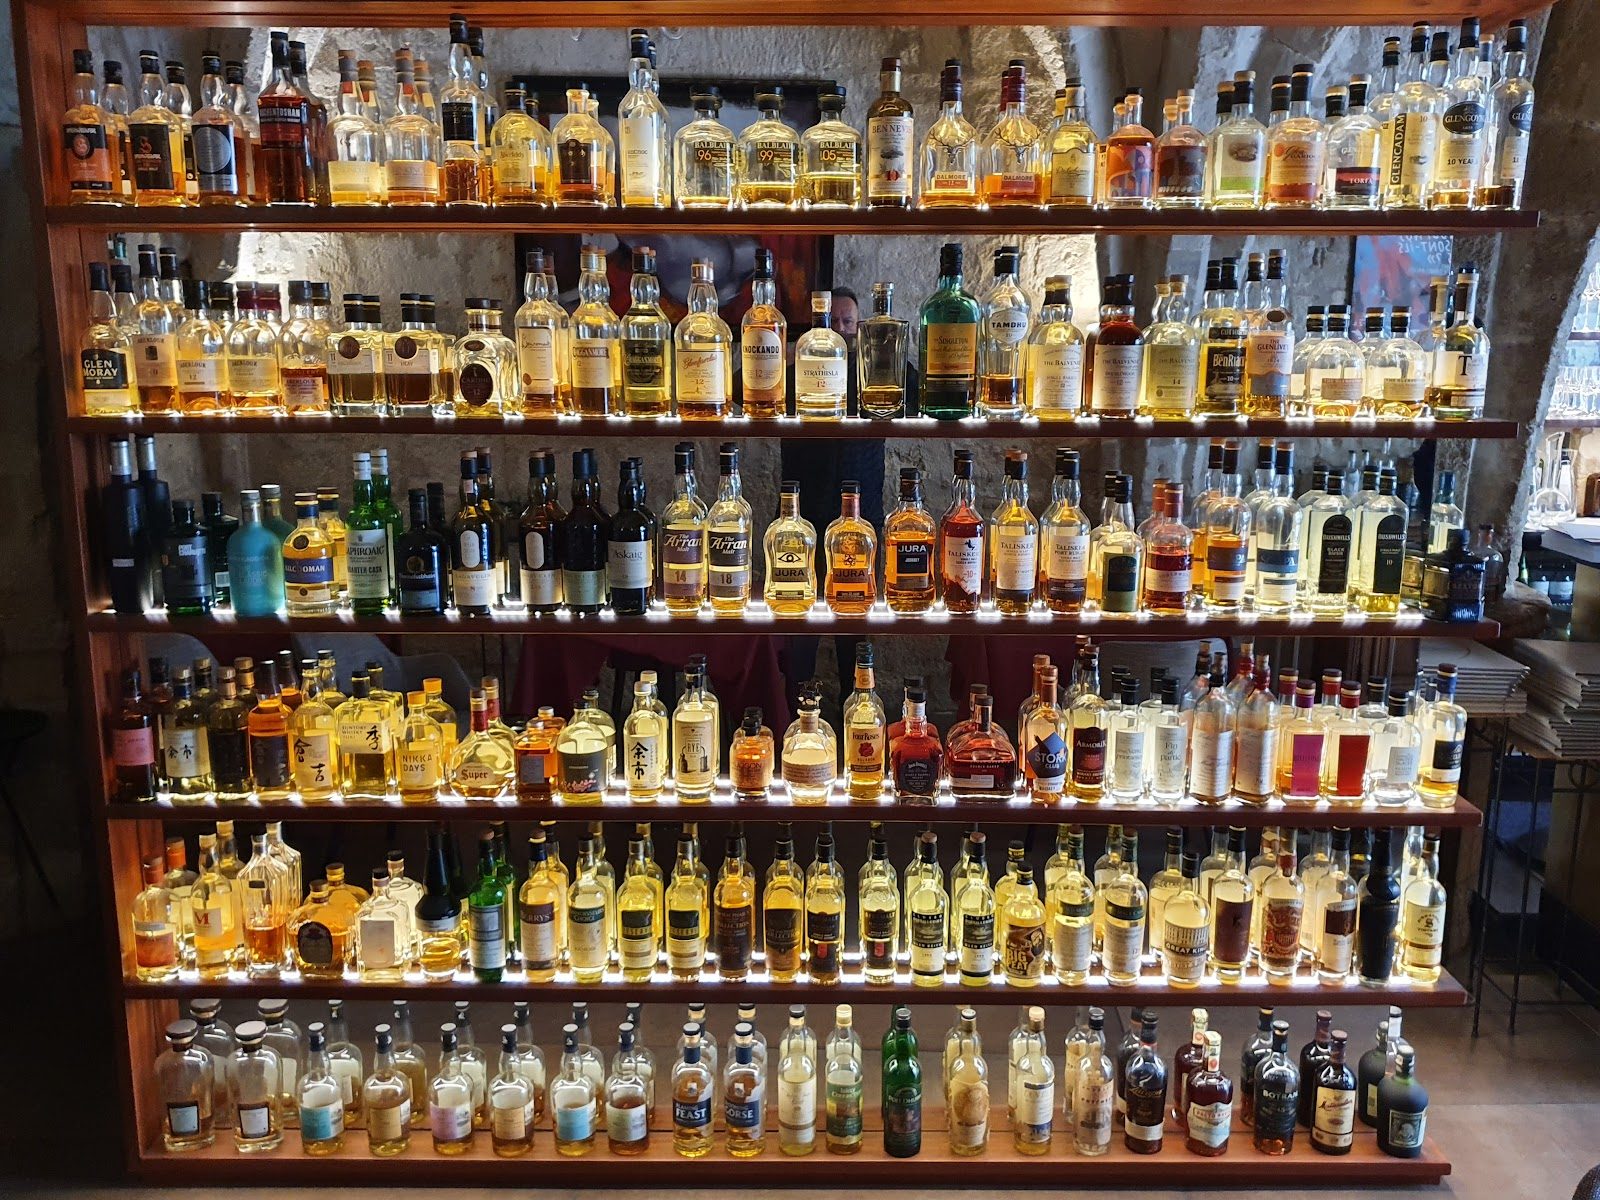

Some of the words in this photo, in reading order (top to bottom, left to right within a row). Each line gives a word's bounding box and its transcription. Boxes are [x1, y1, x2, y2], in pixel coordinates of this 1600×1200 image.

[1391, 113, 1407, 184] GLENCADAM
[759, 150, 774, 161] 99
[991, 321, 1027, 329] TAMDHU
[84, 359, 112, 369] GLEN
[1457, 355, 1473, 377] T
[663, 534, 702, 548] Arran
[710, 536, 747, 550] Arran
[898, 544, 927, 553] JURA
[675, 570, 687, 583] 14
[720, 573, 733, 585] 18
[775, 570, 805, 578] JURA
[835, 570, 865, 578] JURA
[864, 732, 880, 740] Roses
[686, 741, 700, 753] RYE
[402, 754, 433, 763] NIKKA
[1035, 752, 1067, 764] STORK
[403, 763, 426, 773] DAYS
[461, 768, 489, 781] Super
[1165, 942, 1191, 954] GREAT
[1007, 950, 1027, 963] BIG
[675, 1108, 707, 1119] FEAST
